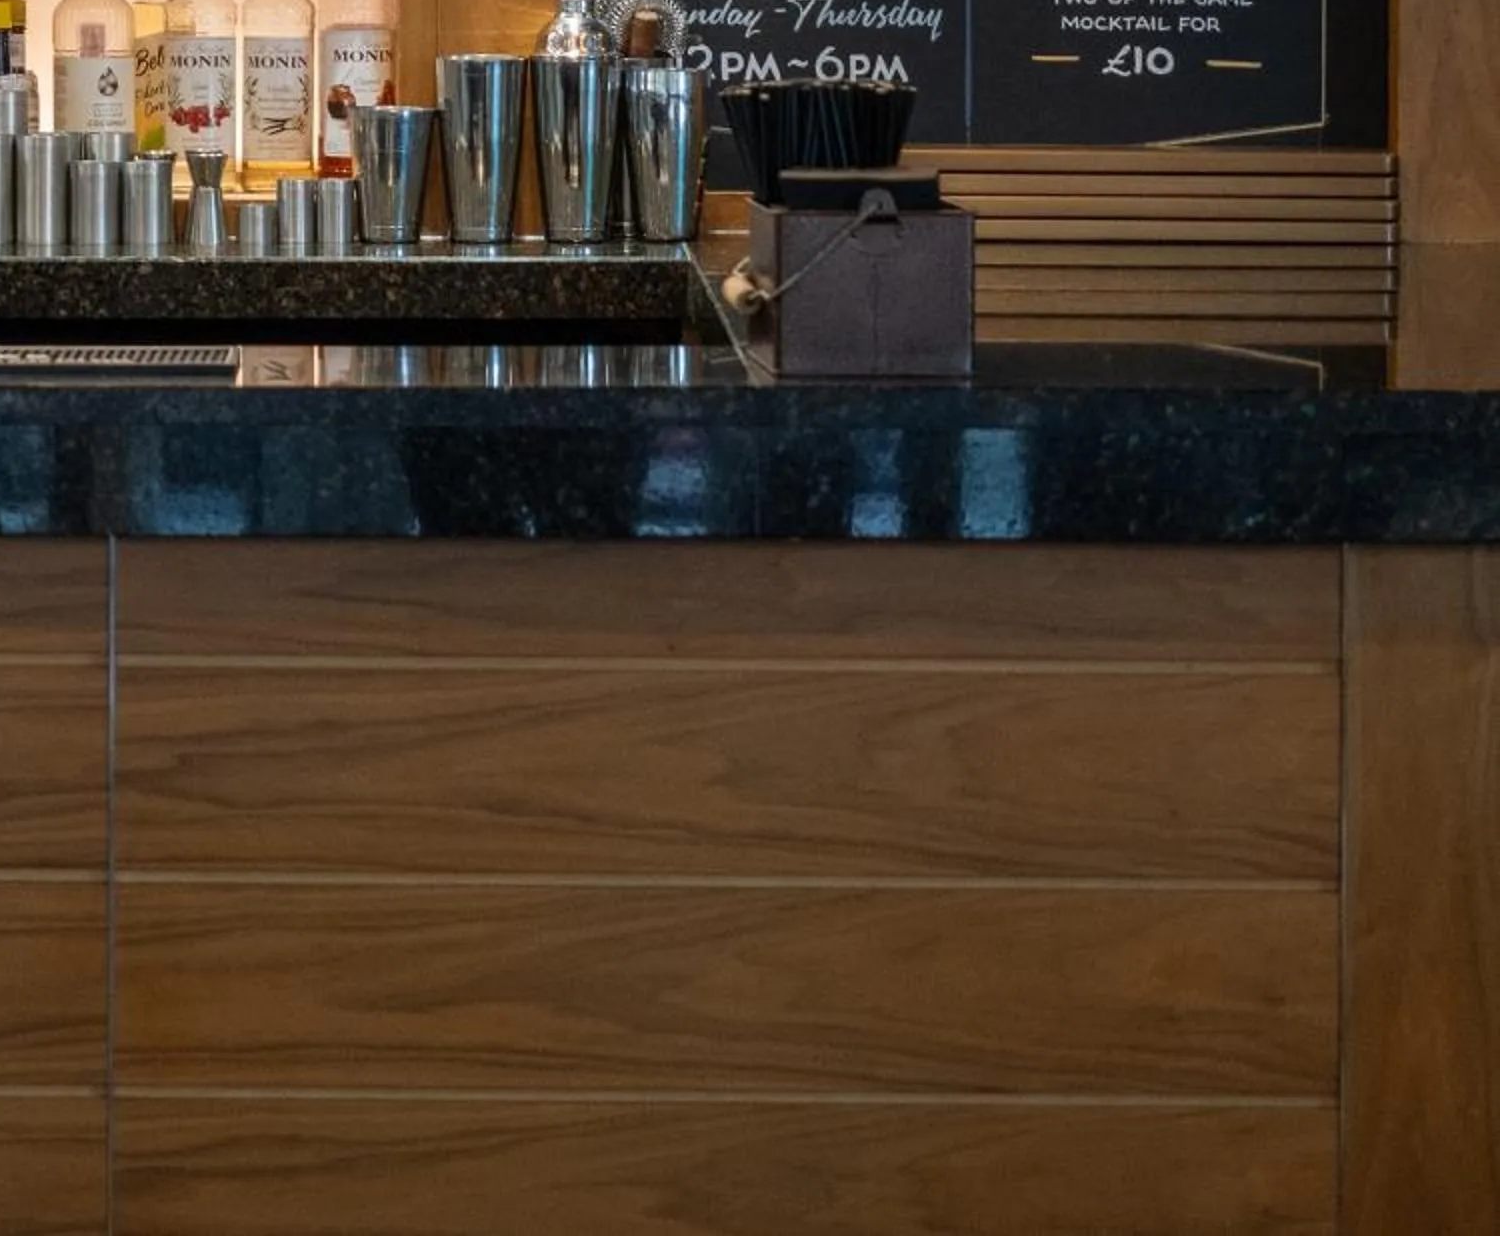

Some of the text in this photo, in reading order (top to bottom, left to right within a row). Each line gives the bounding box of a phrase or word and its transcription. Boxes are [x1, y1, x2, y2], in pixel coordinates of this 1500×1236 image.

[1060, 16, 1221, 33] MOCKTAIL FOR
[171, 54, 231, 68] MONIN
[248, 55, 307, 69] MONIN
[333, 49, 394, 63] MONIN
[1101, 44, 1175, 76] £10
